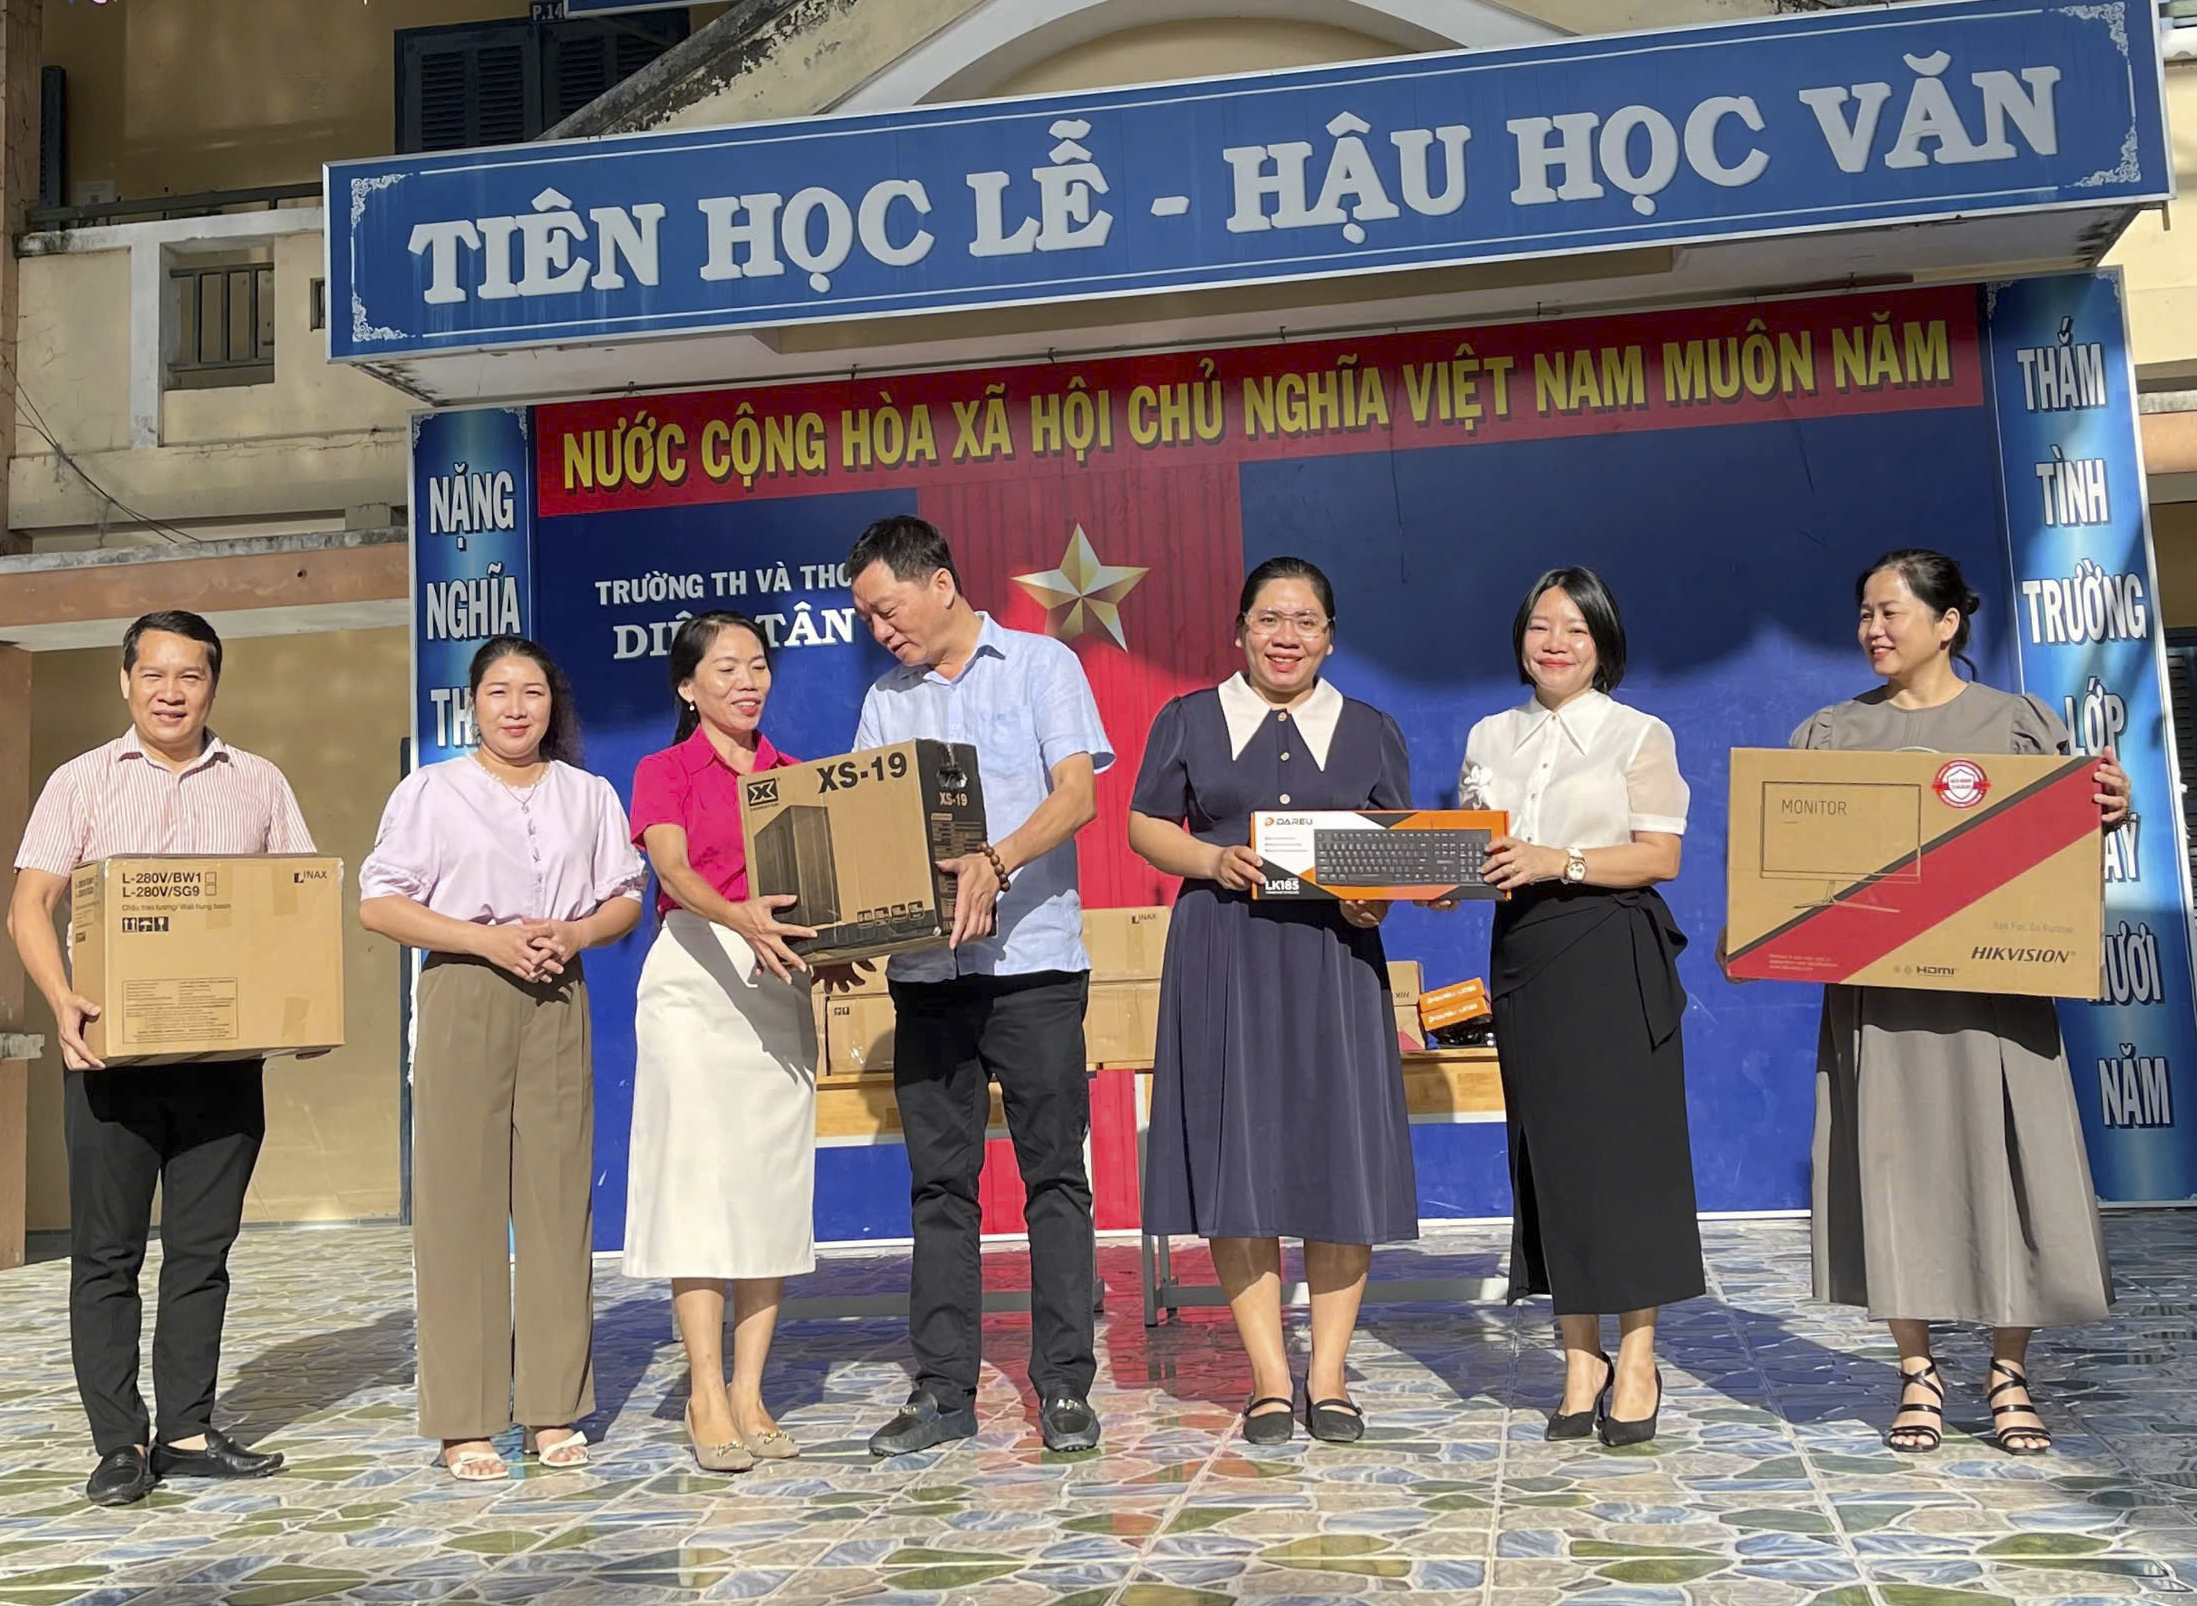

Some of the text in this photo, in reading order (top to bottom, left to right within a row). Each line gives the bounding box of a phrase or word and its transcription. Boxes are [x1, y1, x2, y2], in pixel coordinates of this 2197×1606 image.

[408, 50, 2061, 305] TIÊN HỌC LỄ - HẬU HỌC VĂN
[2016, 316, 2106, 411] THẮM
[563, 312, 1951, 491] NƯỚC CỘNG HÒA XÃ HỘI CHỦ NGHĨA VIỆT NAM MUÔN NĂM
[430, 462, 514, 549] NẶNG
[2036, 445, 2109, 525] TÌNH
[427, 563, 521, 640] NGHĨA
[596, 561, 852, 606] TRƯỜNG TH VÀ THC
[2022, 559, 2147, 643] TRƯỜNG
[754, 601, 856, 648] TÂN
[2064, 676, 2125, 757] LỚP
[817, 751, 908, 794] XS-19
[939, 792, 968, 807] XS-19
[1276, 817, 1313, 826] DAREU
[1780, 799, 1847, 817] MONITOR
[122, 872, 201, 884] L-280V/BW1
[122, 886, 200, 898] L-280V/SG9
[1265, 880, 1300, 891] LK185
[1916, 965, 1955, 975] HDMI
[1971, 946, 2070, 963] HIKVISION
[2098, 1044, 2171, 1126] NĂM
